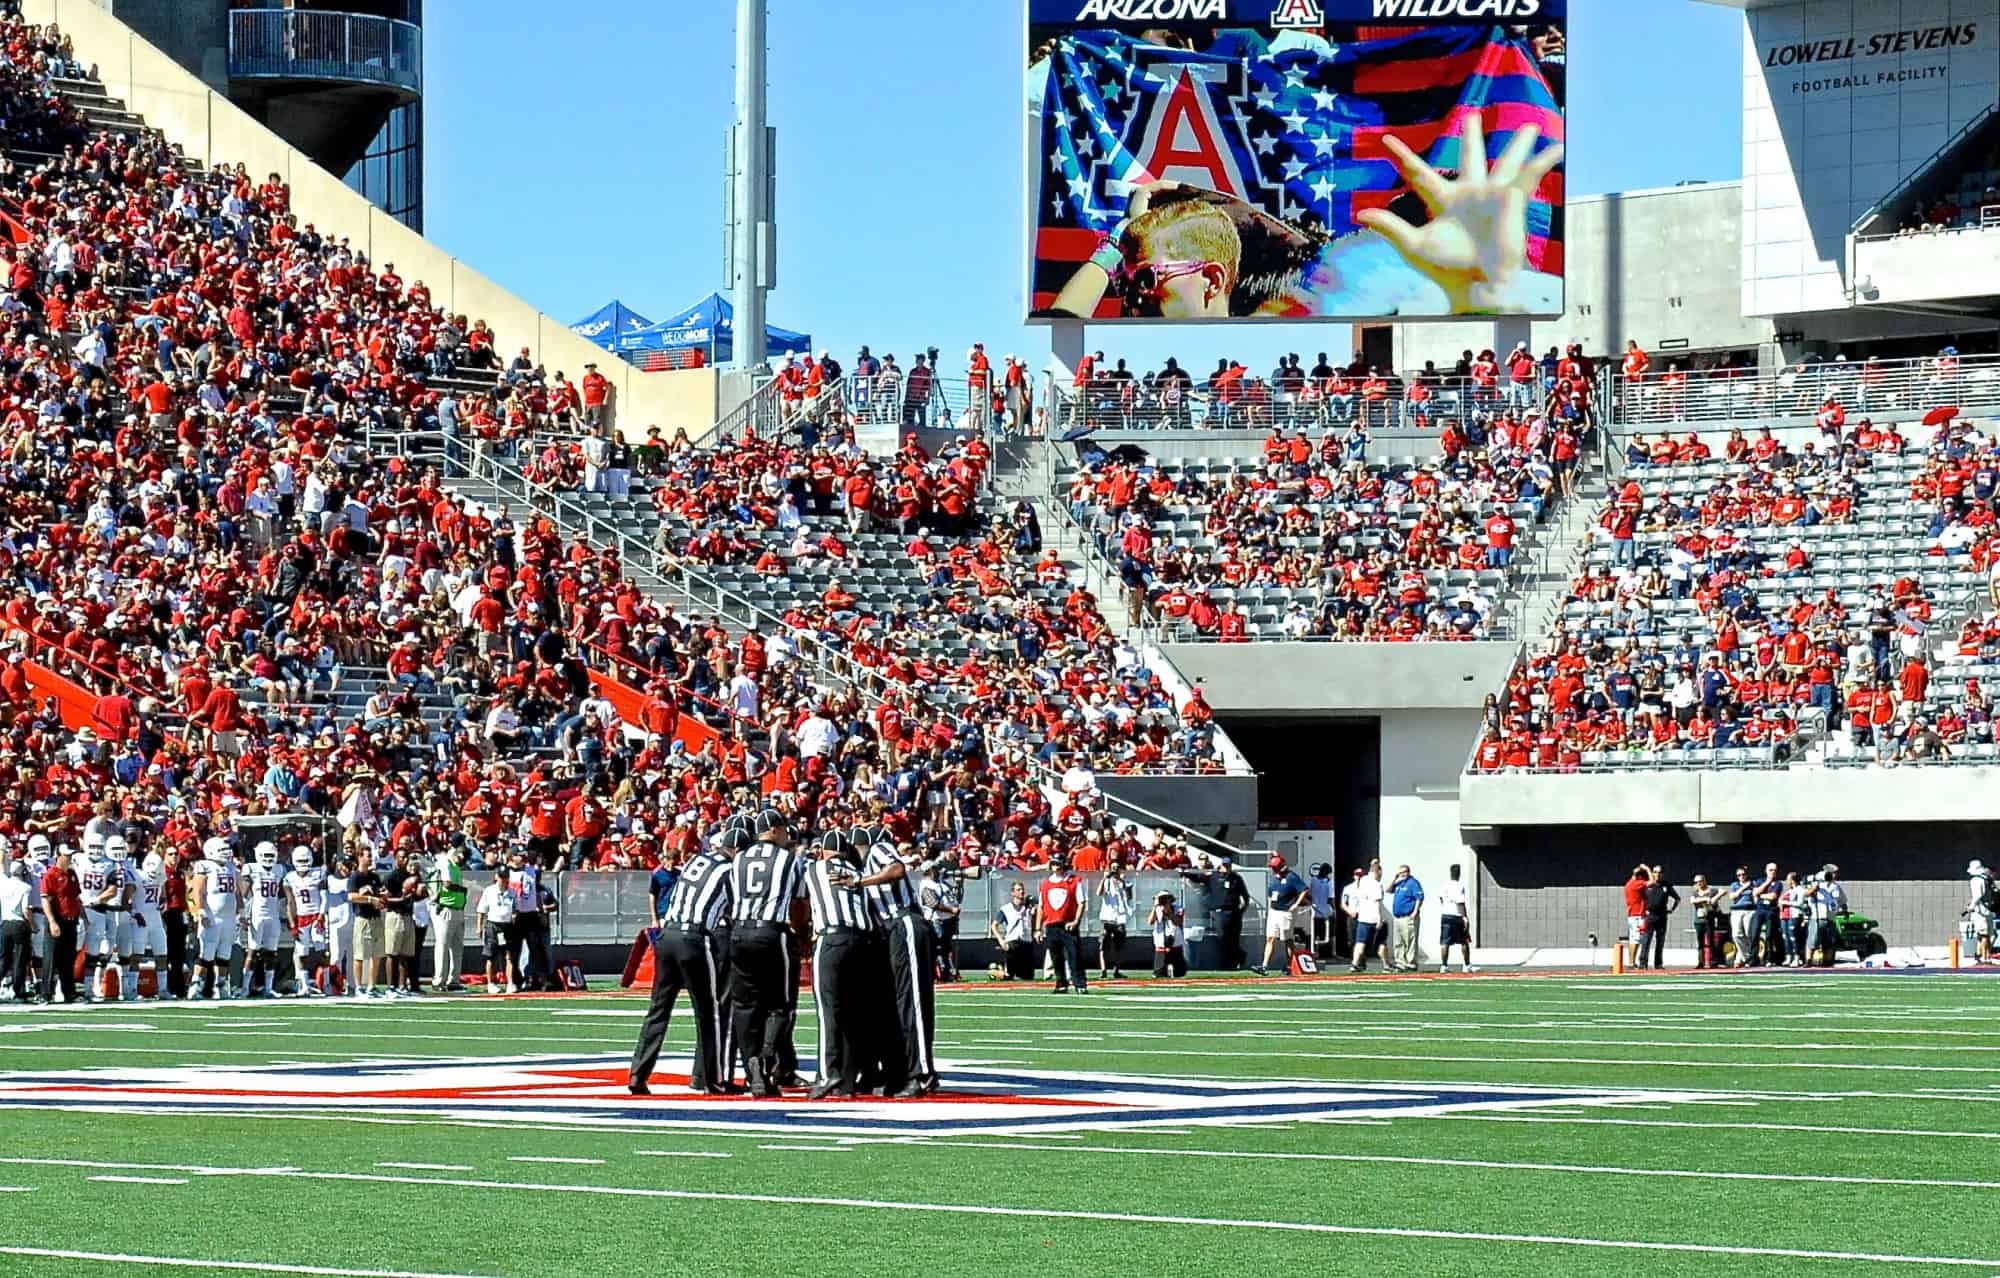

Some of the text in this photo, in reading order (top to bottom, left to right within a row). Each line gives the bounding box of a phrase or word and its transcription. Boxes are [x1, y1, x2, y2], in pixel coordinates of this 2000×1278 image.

[1075, 0, 1227, 21] ARIZONA
[1765, 23, 1977, 67] LOWELL-STEVENS
[1792, 66, 1948, 93] FOOTBALL FACILITY
[684, 854, 709, 882] B
[745, 860, 766, 894] C
[83, 872, 104, 890] 63
[219, 876, 235, 893] 58
[260, 880, 278, 898] 80
[1297, 953, 1318, 973] G
